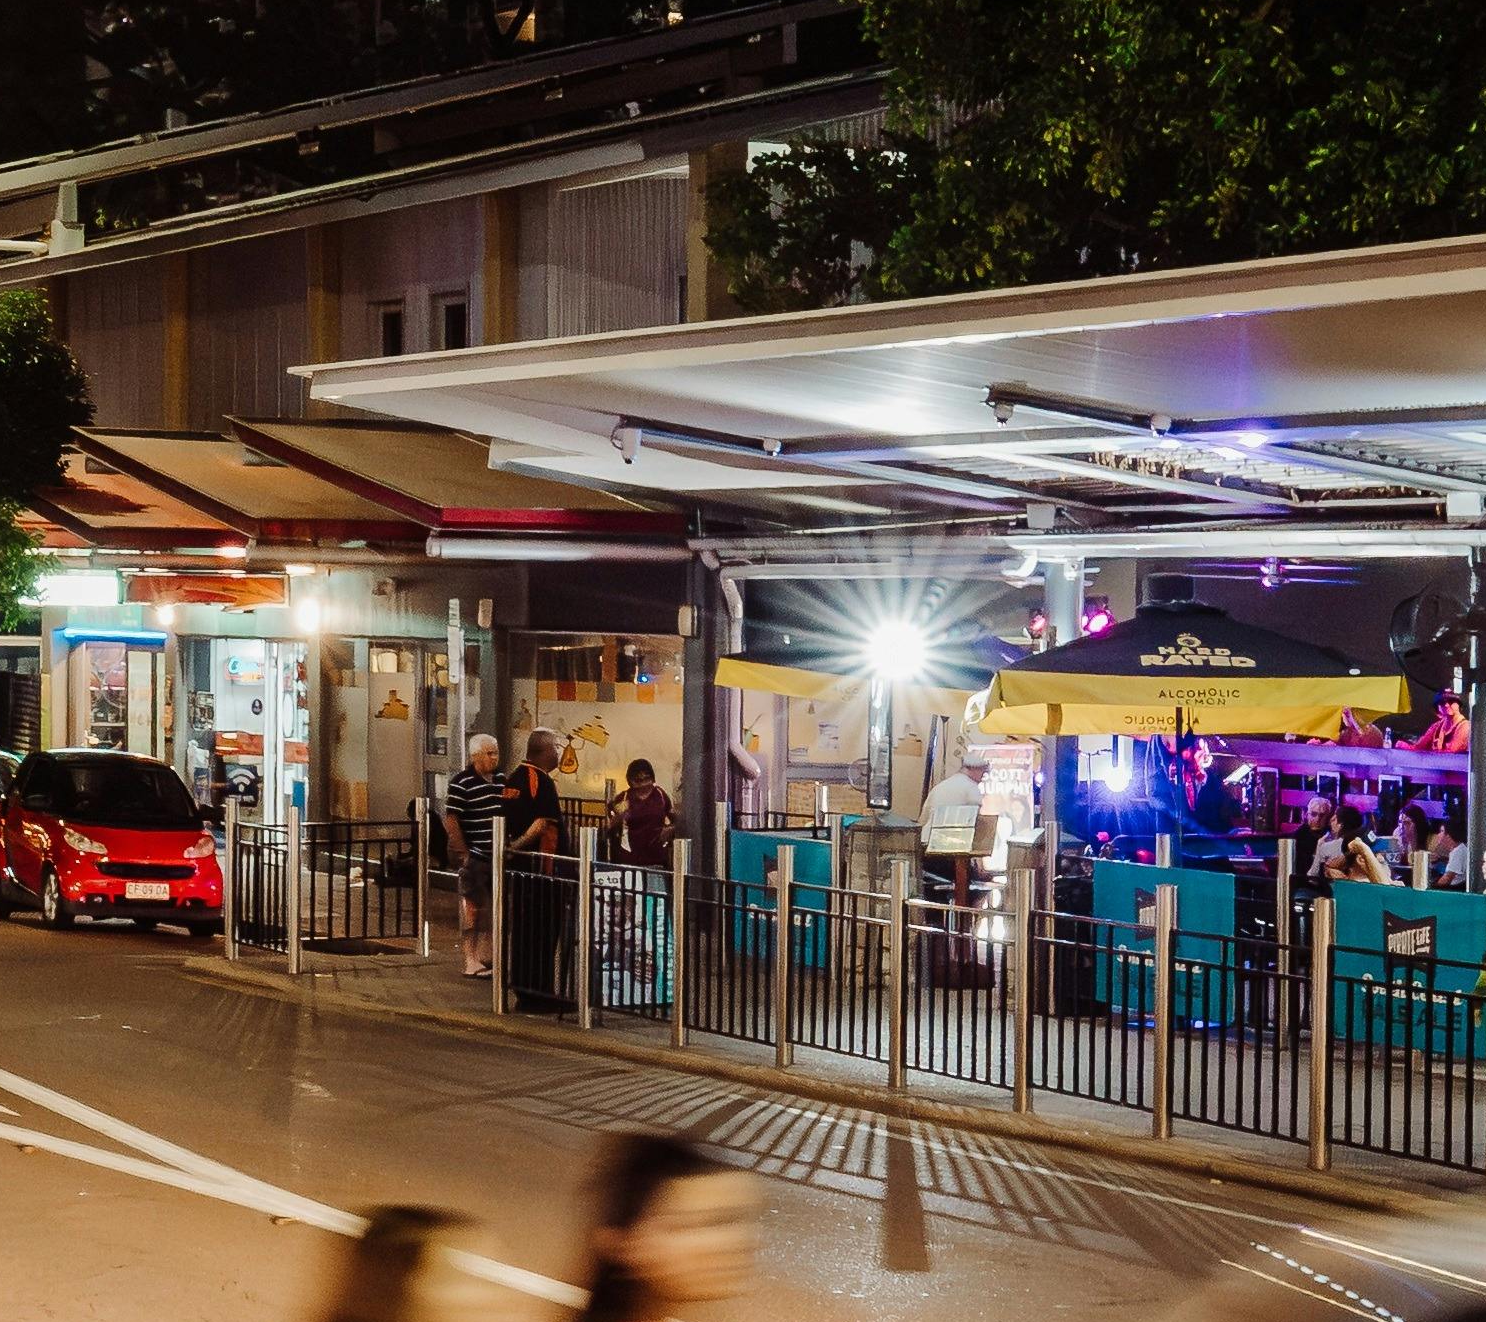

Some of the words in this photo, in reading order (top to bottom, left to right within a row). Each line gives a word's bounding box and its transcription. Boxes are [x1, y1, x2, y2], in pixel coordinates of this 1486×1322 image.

[1157, 646, 1232, 656] HARD
[1140, 654, 1257, 668] RATED
[1158, 687, 1241, 699] ALCOHOLIC
